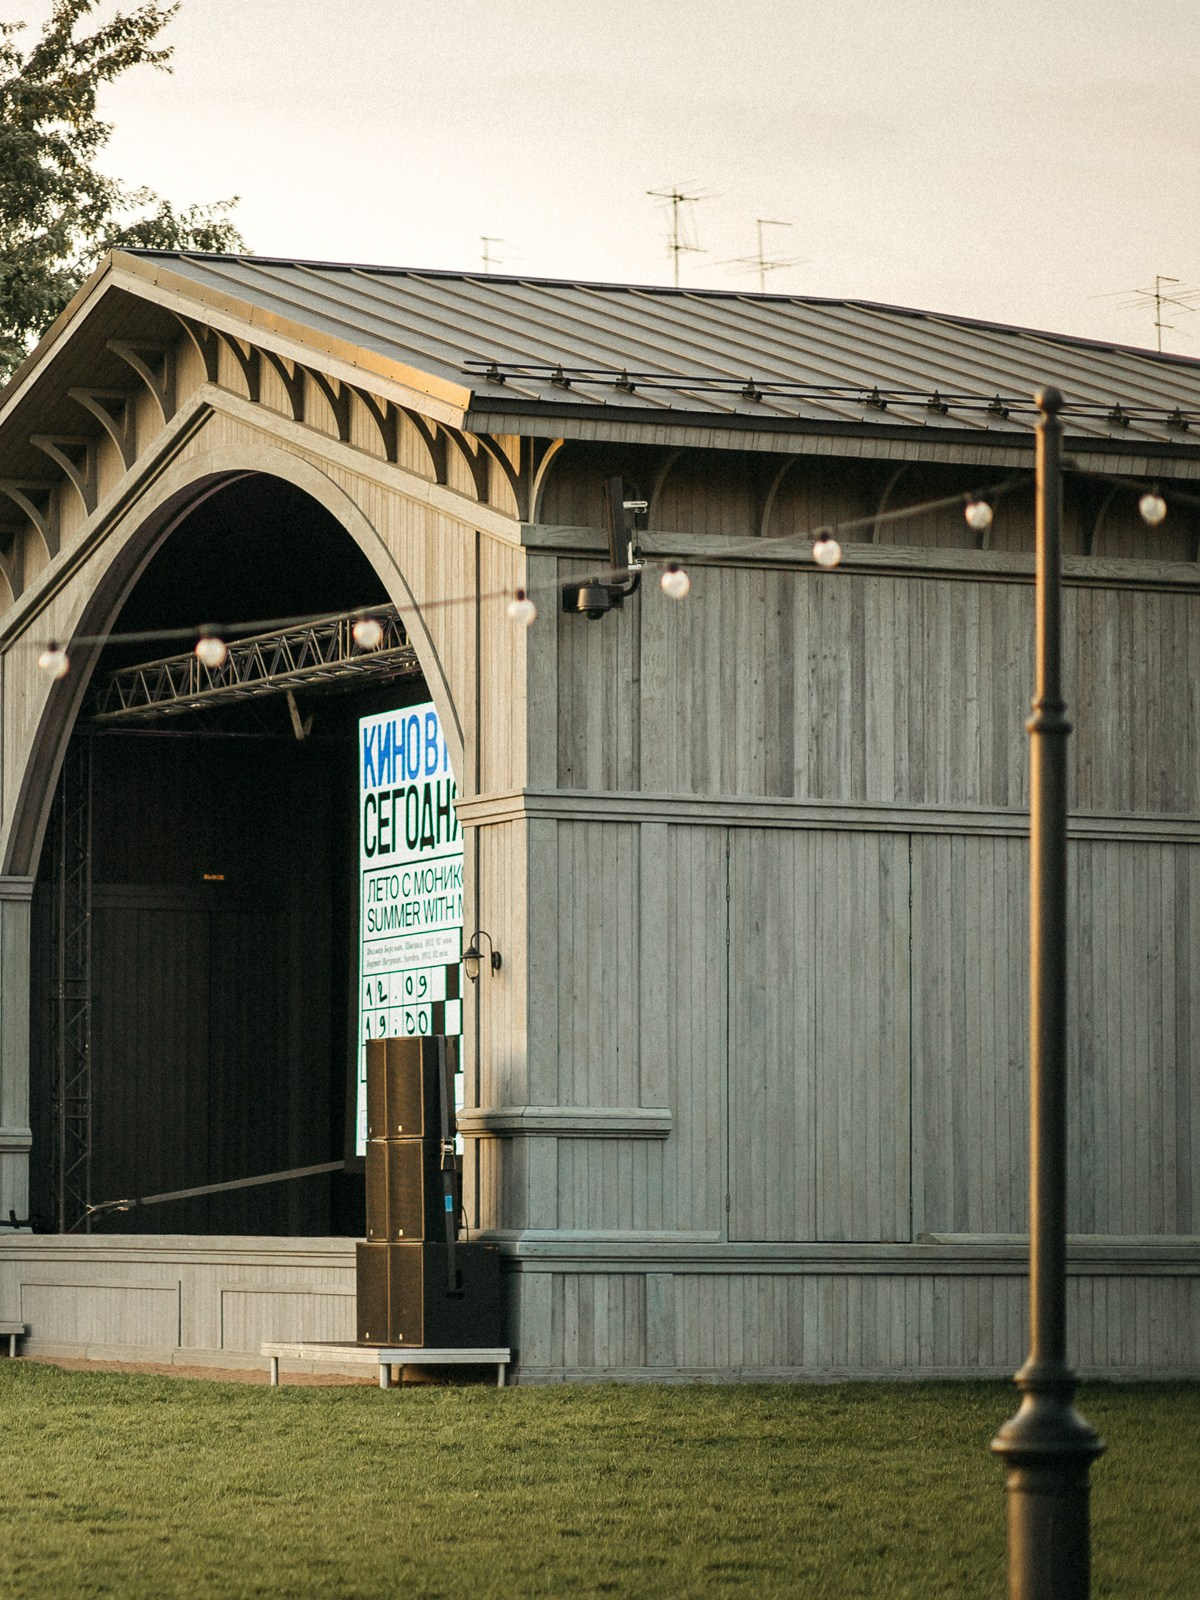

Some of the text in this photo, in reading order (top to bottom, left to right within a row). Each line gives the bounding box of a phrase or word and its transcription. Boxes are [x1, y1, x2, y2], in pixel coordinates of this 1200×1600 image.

[363, 714, 420, 790] КИНО
[367, 874, 399, 903] ЛЕТО
[402, 872, 411, 897] С
[367, 901, 421, 933] SUMMER
[423, 894, 455, 924] WITH
